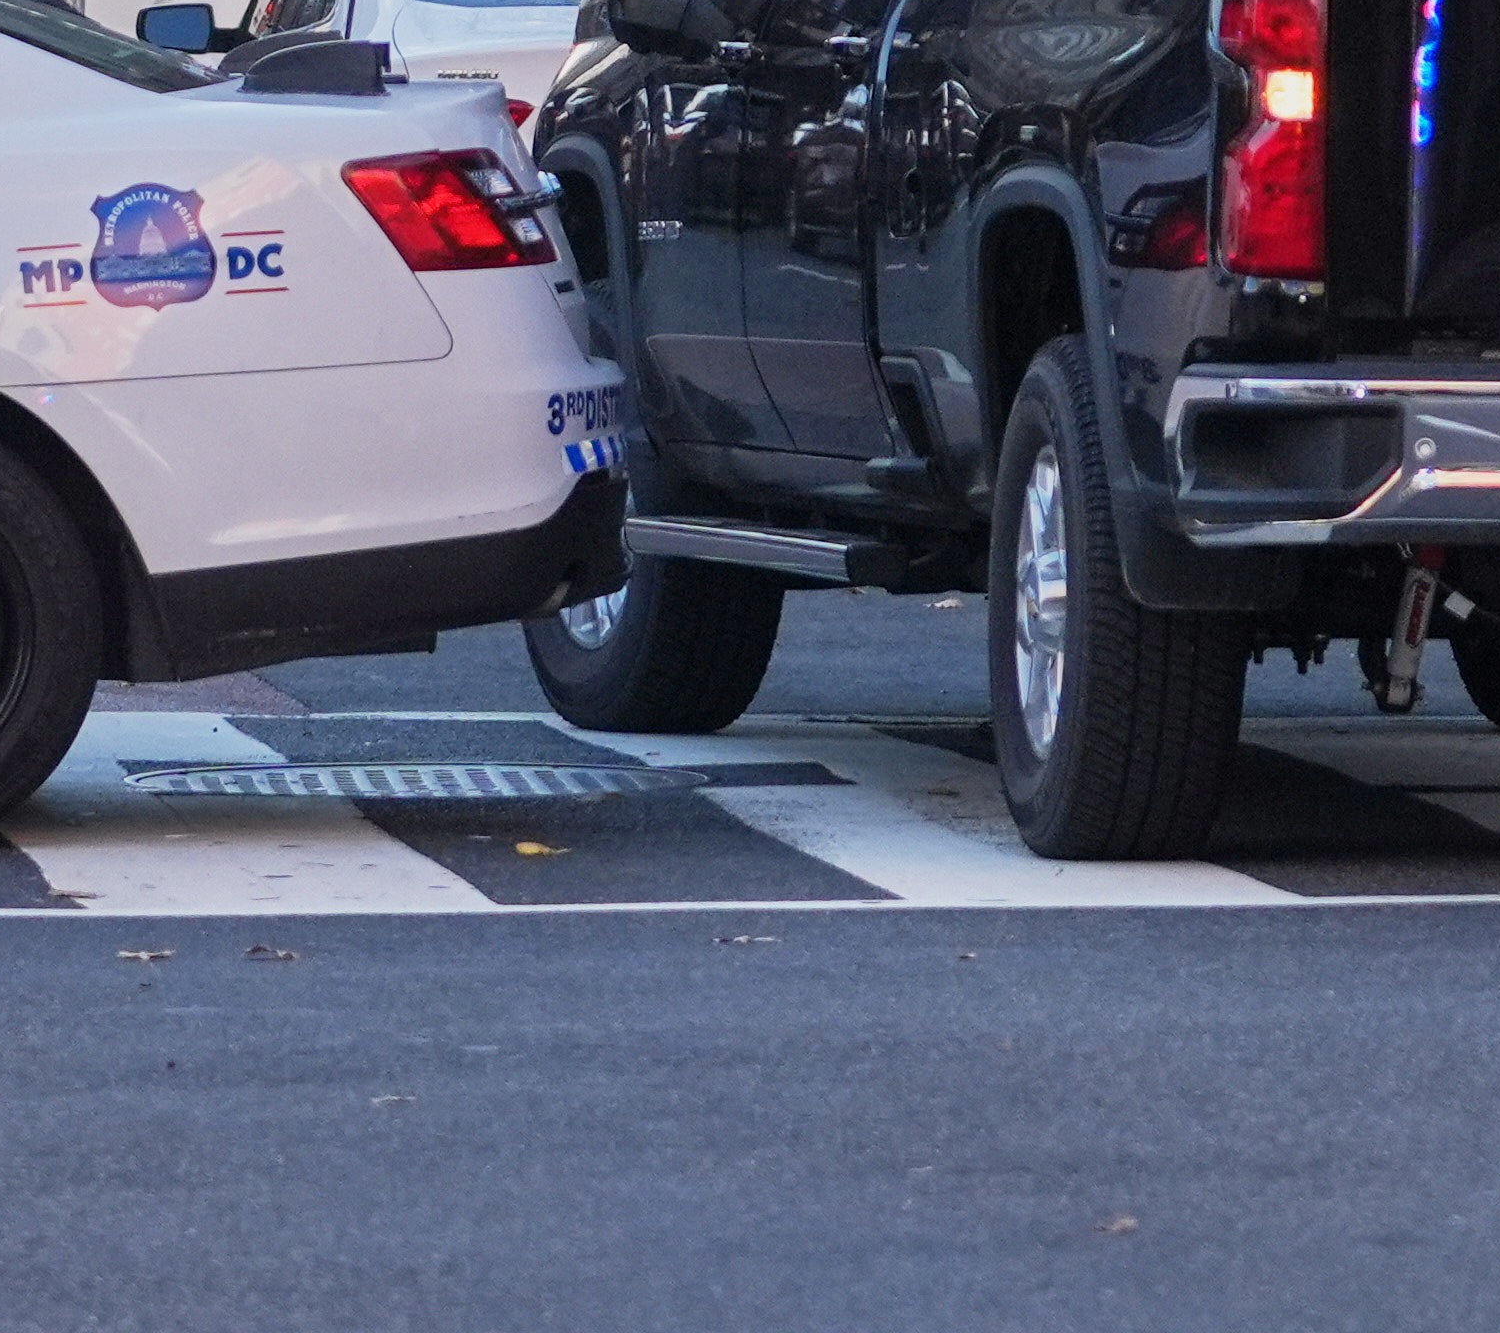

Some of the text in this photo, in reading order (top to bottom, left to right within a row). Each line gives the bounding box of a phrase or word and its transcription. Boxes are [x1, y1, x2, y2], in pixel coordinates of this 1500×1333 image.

[172, 202, 198, 240] POLICE
[19, 259, 84, 294] MP
[227, 243, 284, 280] DC
